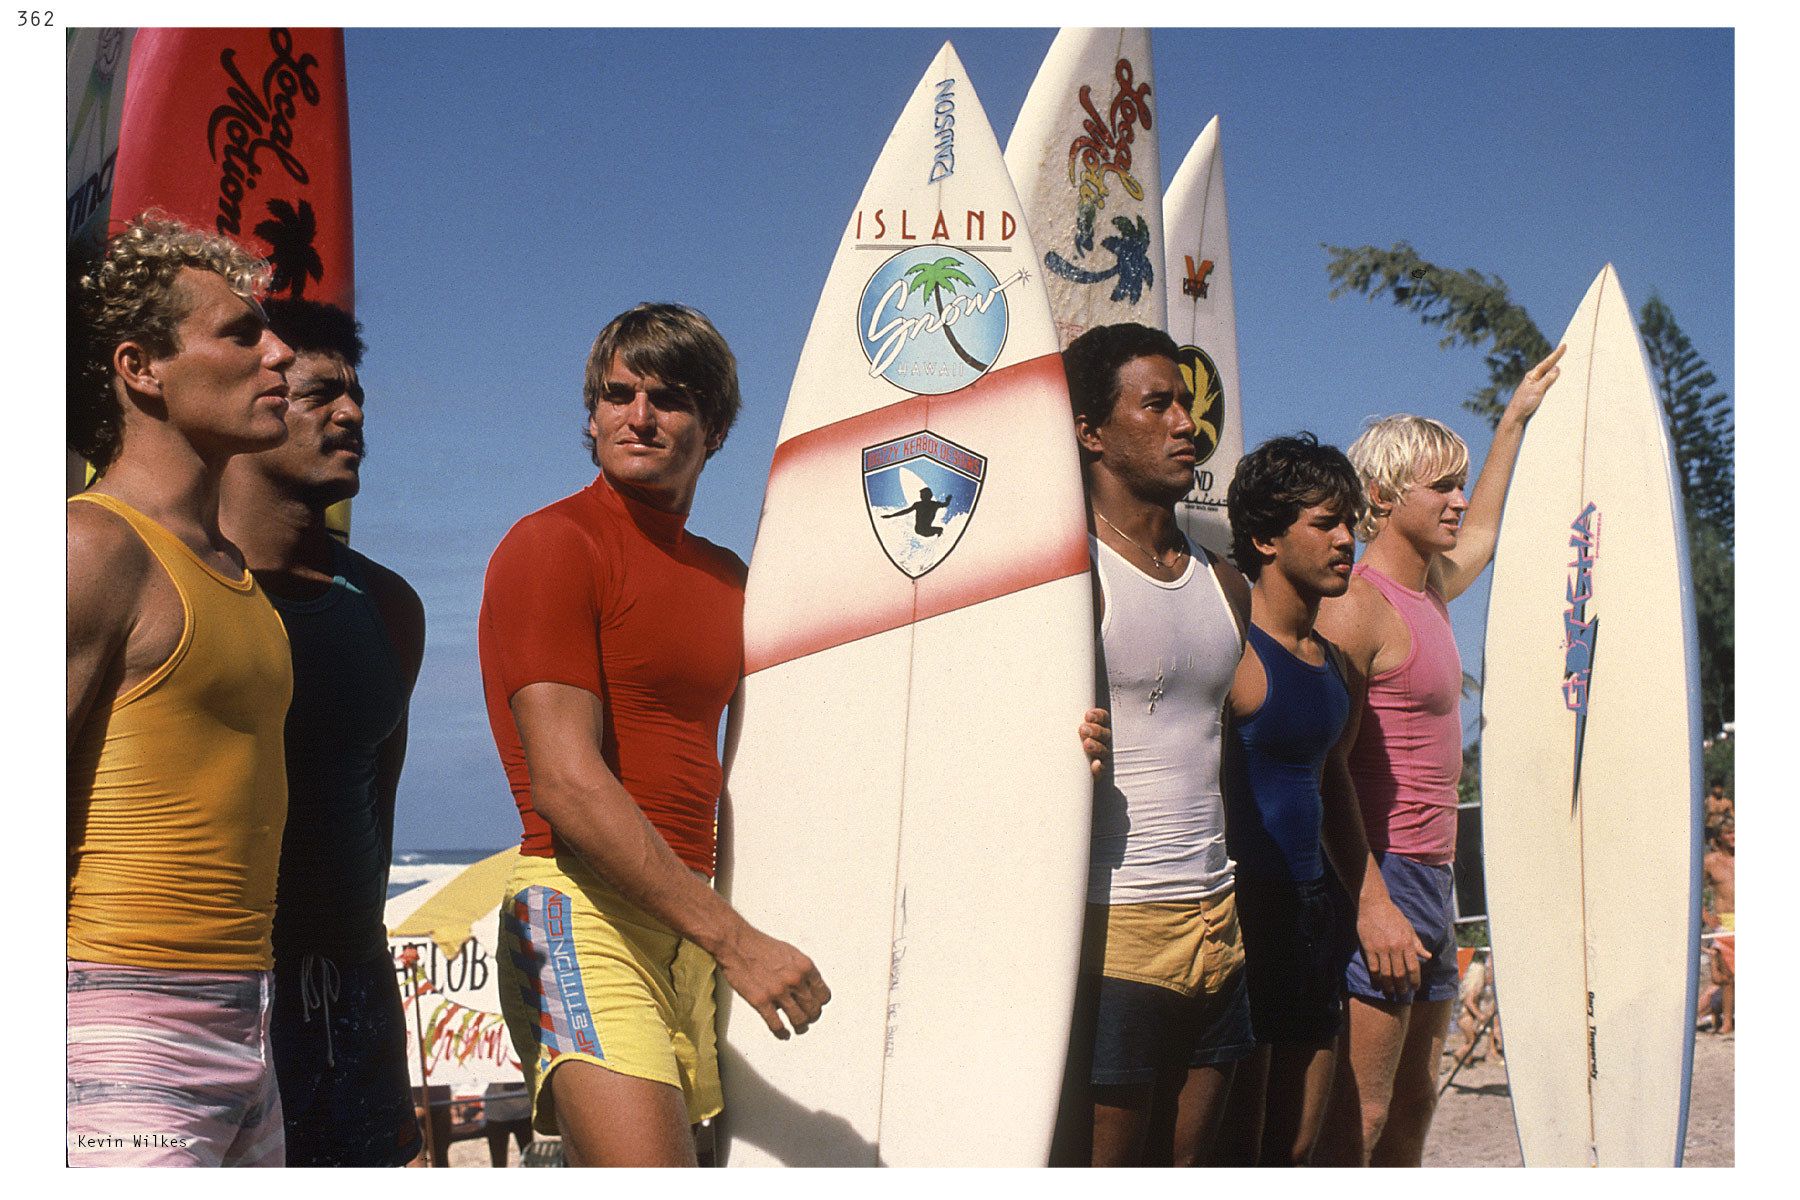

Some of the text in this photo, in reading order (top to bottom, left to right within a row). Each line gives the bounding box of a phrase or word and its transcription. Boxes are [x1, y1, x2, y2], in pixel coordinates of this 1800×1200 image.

[207, 48, 269, 237] Motion
[1101, 59, 1152, 201] Local
[856, 210, 1017, 241] ISLAND
[868, 270, 1031, 379] Snow
[897, 361, 964, 377] HAWAII
